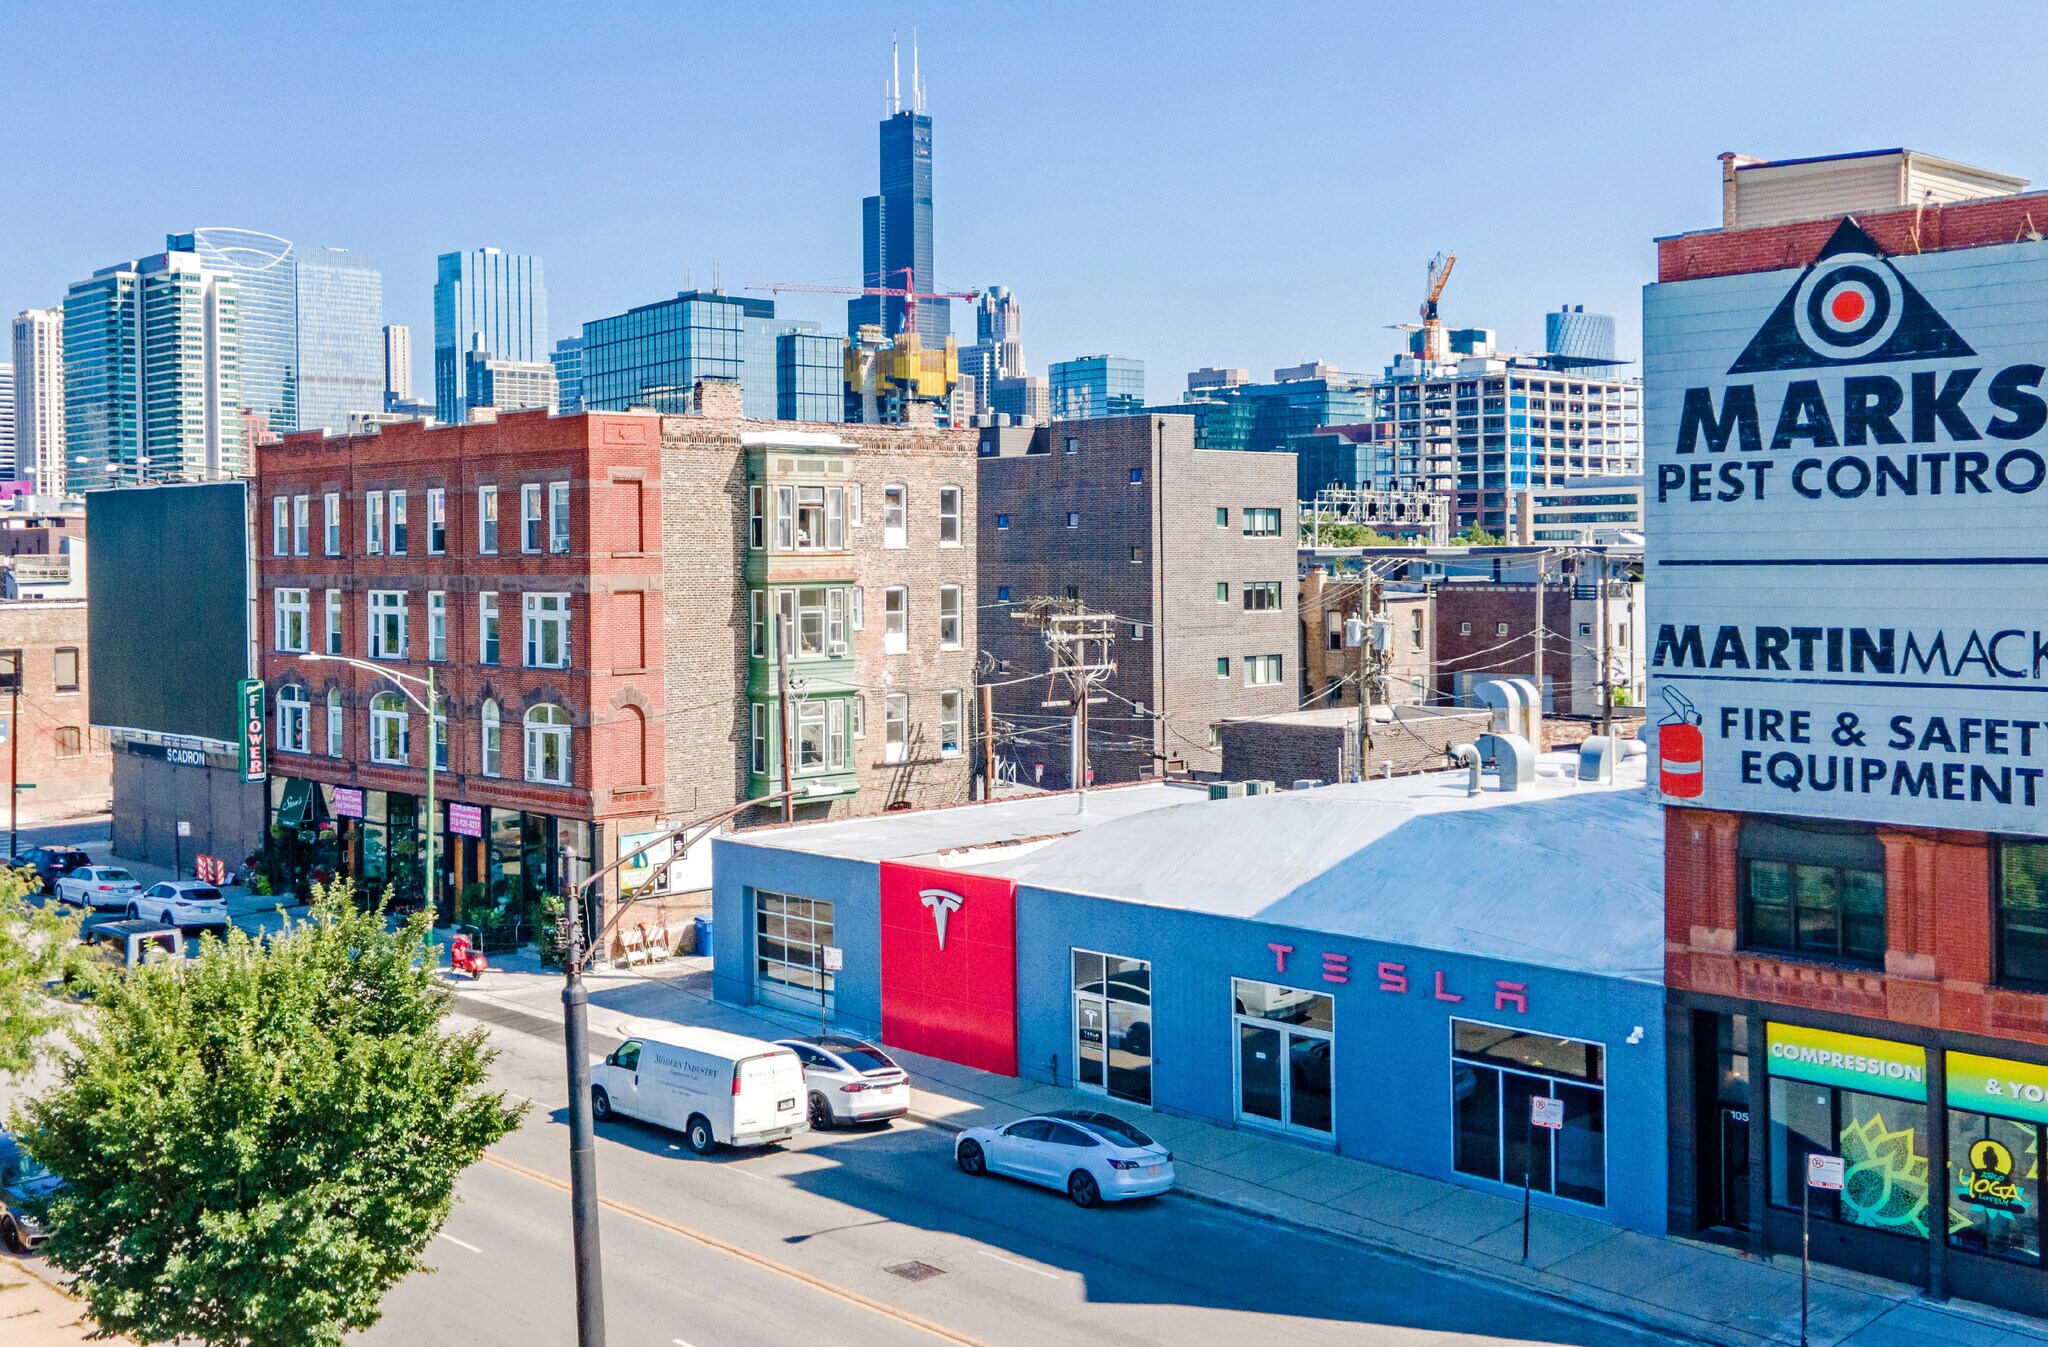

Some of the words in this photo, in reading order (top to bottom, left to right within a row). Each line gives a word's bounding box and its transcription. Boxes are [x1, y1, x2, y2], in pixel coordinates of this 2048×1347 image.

[1676, 364, 2048, 454] MARKS
[1658, 460, 1773, 502] PEST
[1791, 448, 2047, 499] CONTRO
[248, 694, 263, 773] FLOWER
[1721, 706, 1810, 743] FIRE
[1831, 711, 1866, 747] &
[1888, 715, 2048, 757] SAFET
[166, 748, 206, 766] SCADRON
[1741, 750, 2044, 806] EQUIPMENT
[1267, 943, 1527, 1013] TESLA
[655, 1053, 682, 1069] MODERN
[683, 1061, 719, 1078] INDUSTRY
[1771, 1042, 1923, 1083] COMPRESSION
[1985, 1078, 2004, 1097] &
[2008, 1081, 2048, 1103] YO
[1730, 1110, 1749, 1122] 105
[1958, 1168, 2025, 1202] YOGA
